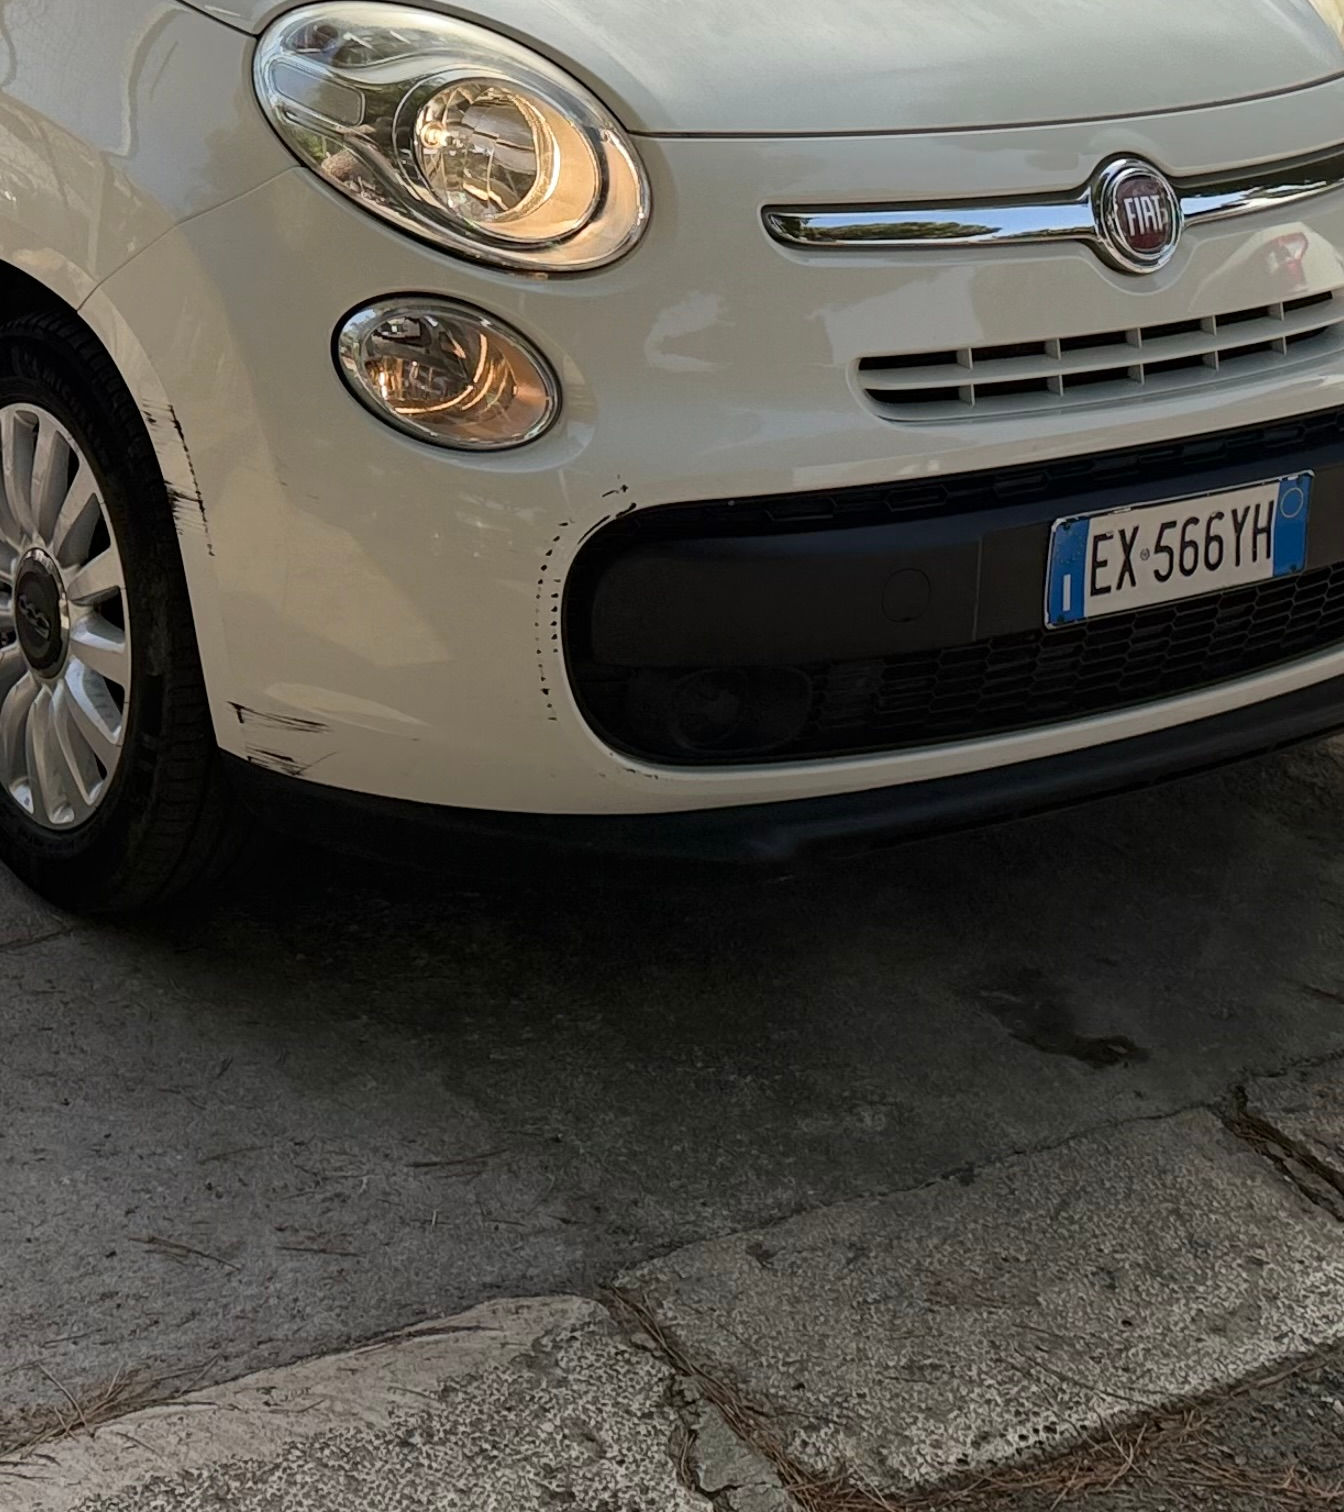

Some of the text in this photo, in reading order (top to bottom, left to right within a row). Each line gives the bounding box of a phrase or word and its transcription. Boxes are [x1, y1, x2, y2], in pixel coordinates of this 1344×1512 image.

[1123, 195, 1162, 237] FIAT
[1090, 499, 1275, 596] EX 566YH
